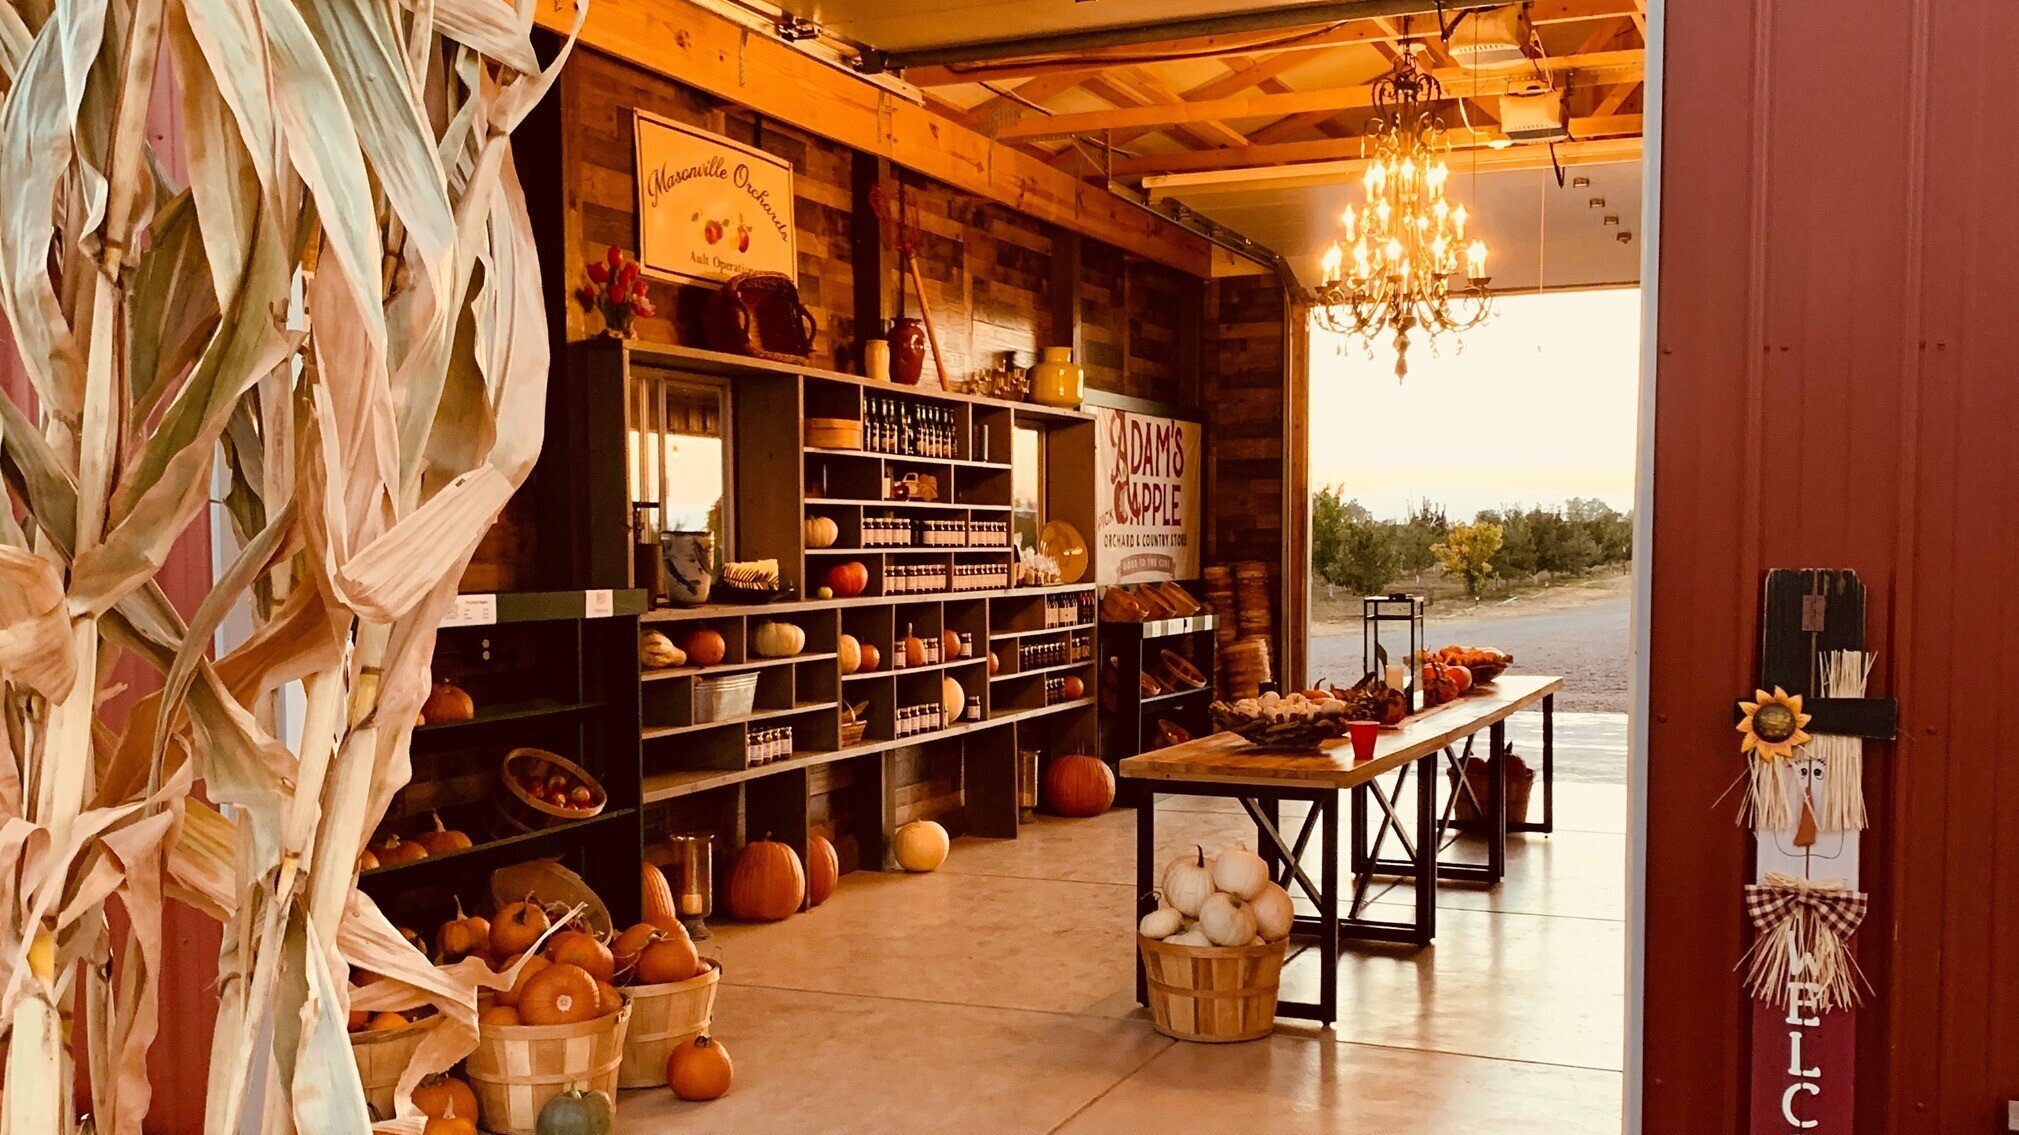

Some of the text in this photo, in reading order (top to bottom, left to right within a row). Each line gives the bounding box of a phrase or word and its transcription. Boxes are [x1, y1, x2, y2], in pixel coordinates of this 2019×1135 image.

[647, 156, 789, 243] Masonville Orchards
[689, 250, 709, 266] Ault
[1110, 409, 1185, 485] ADAM'S
[1129, 481, 1182, 527] APPLE
[1103, 533, 1187, 548] ORCHARD & COUNTRY STORE
